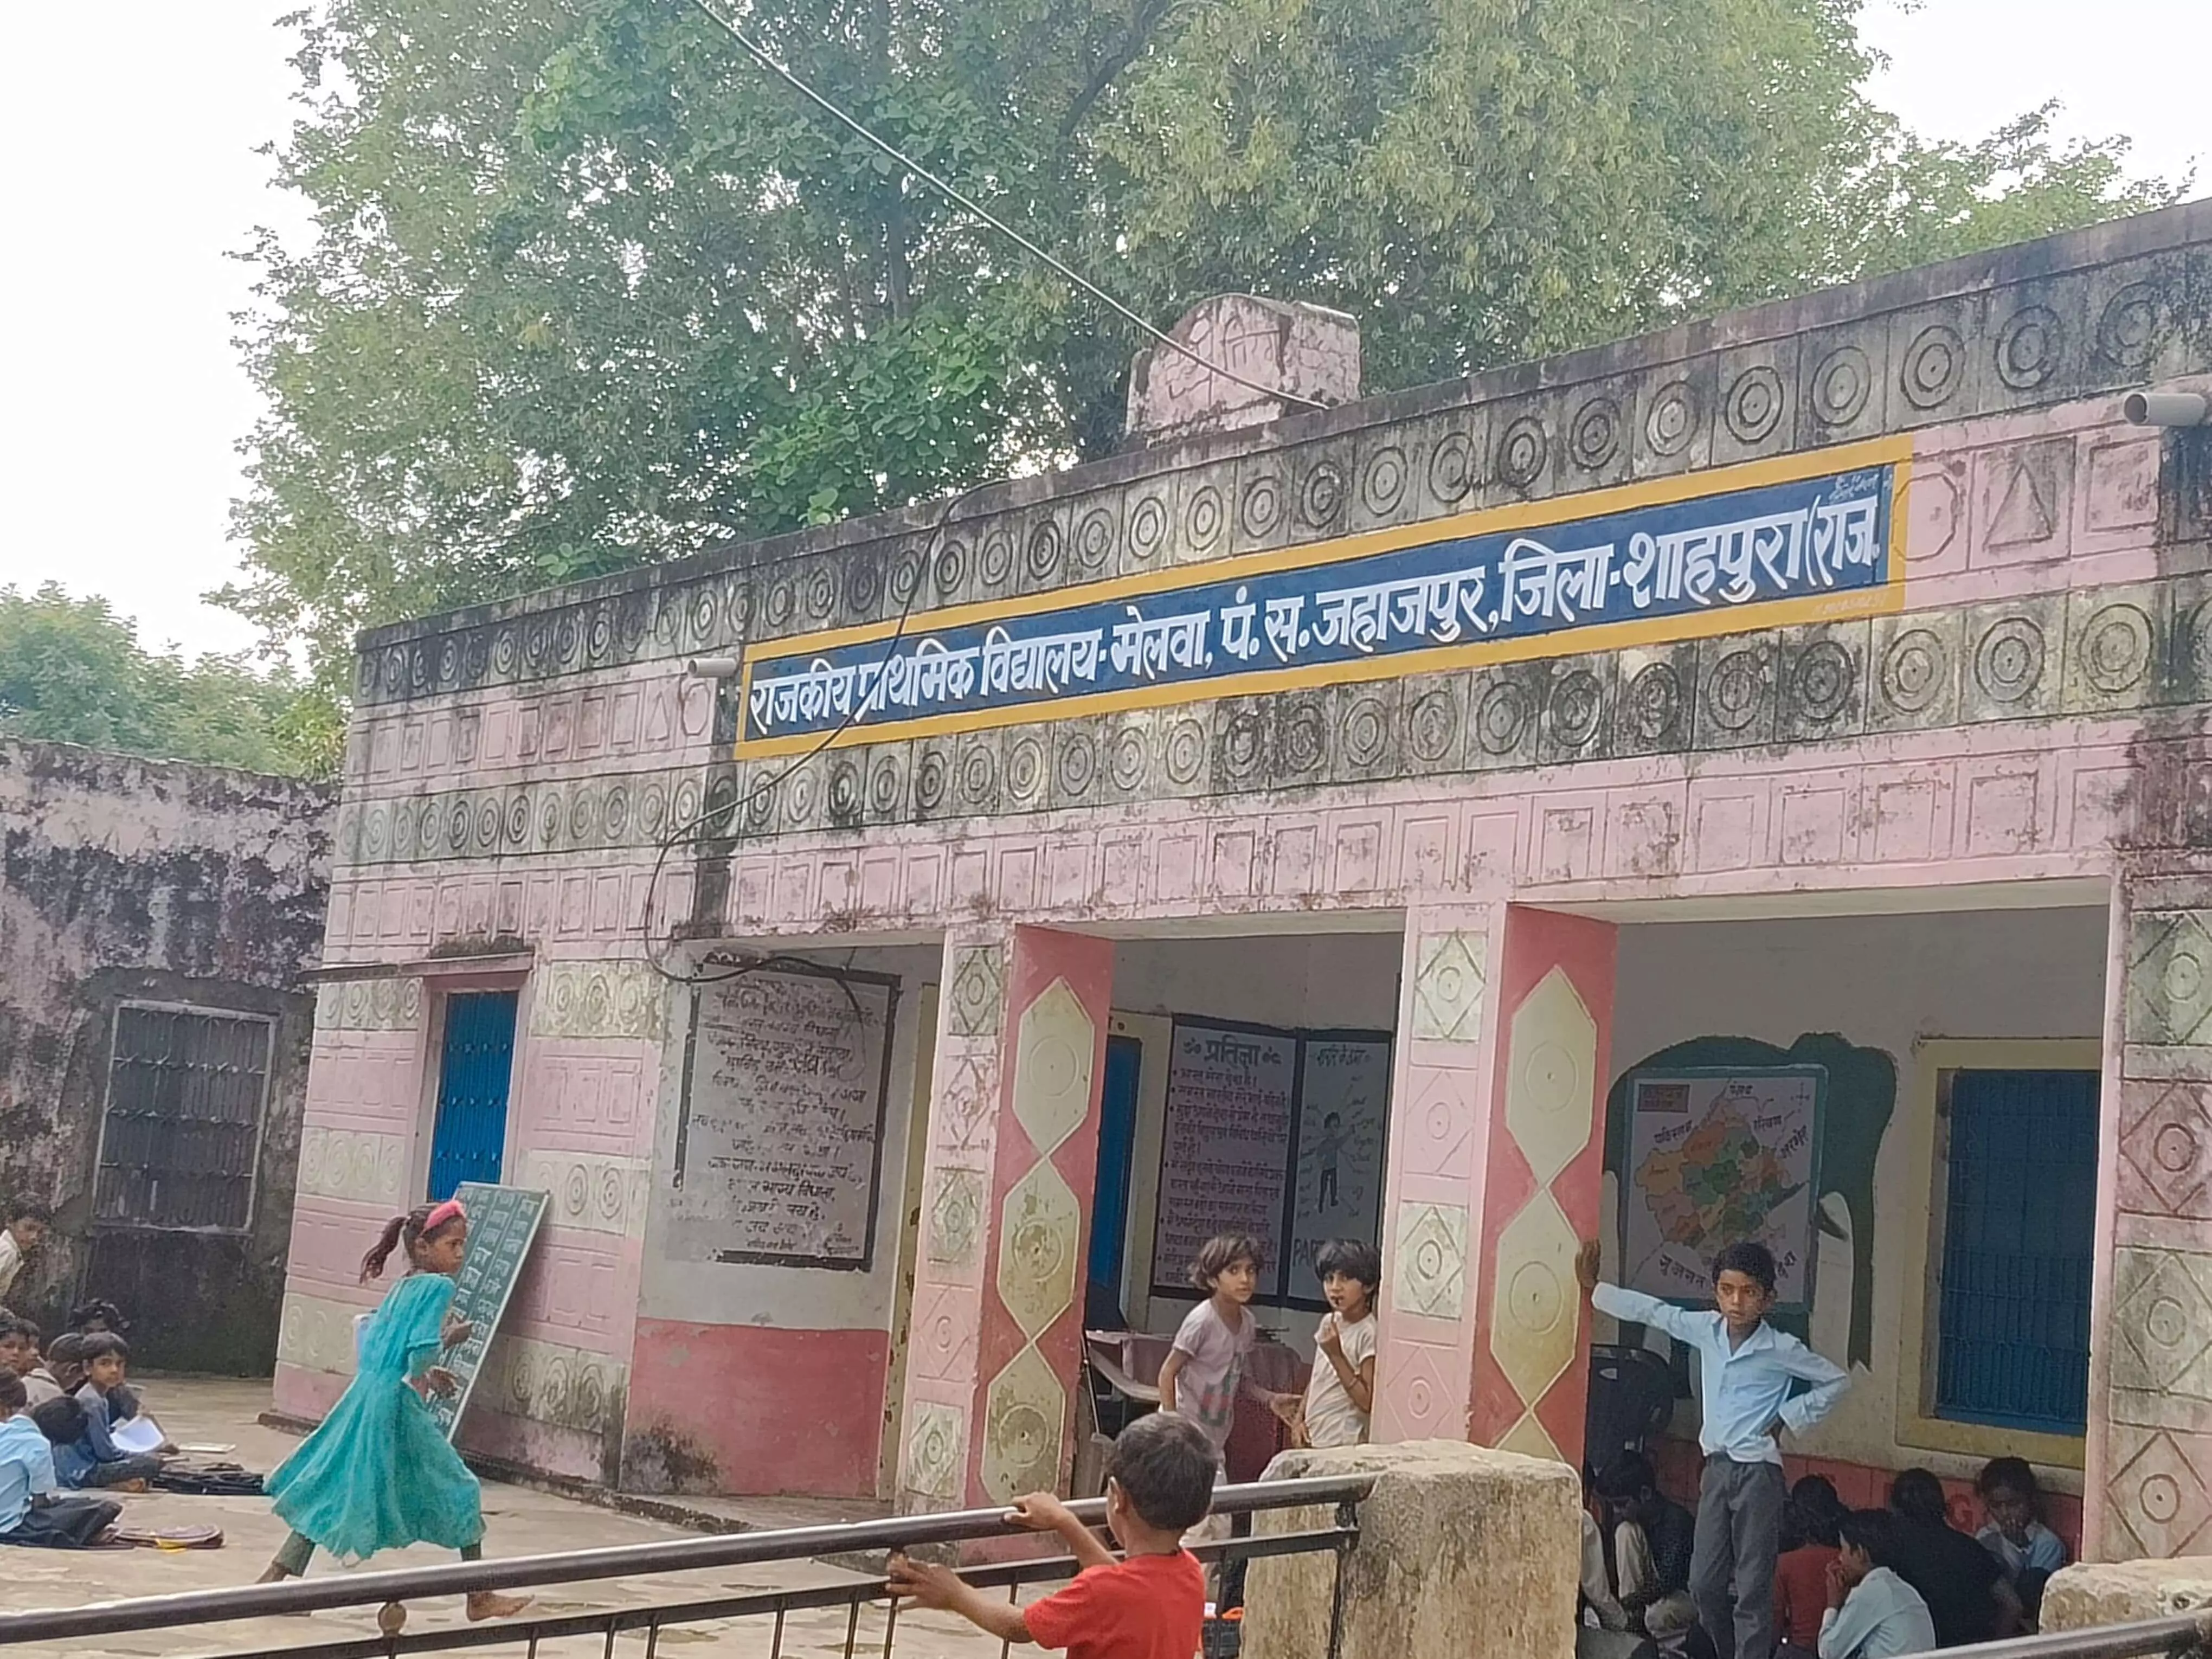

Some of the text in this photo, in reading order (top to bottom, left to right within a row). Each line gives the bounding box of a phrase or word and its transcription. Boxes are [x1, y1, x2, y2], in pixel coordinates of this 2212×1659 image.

[749, 658, 853, 735] राजकीय
[854, 638, 979, 723] प्राथमिक
[1204, 1033, 1261, 1068] प्रतिज्ञा
